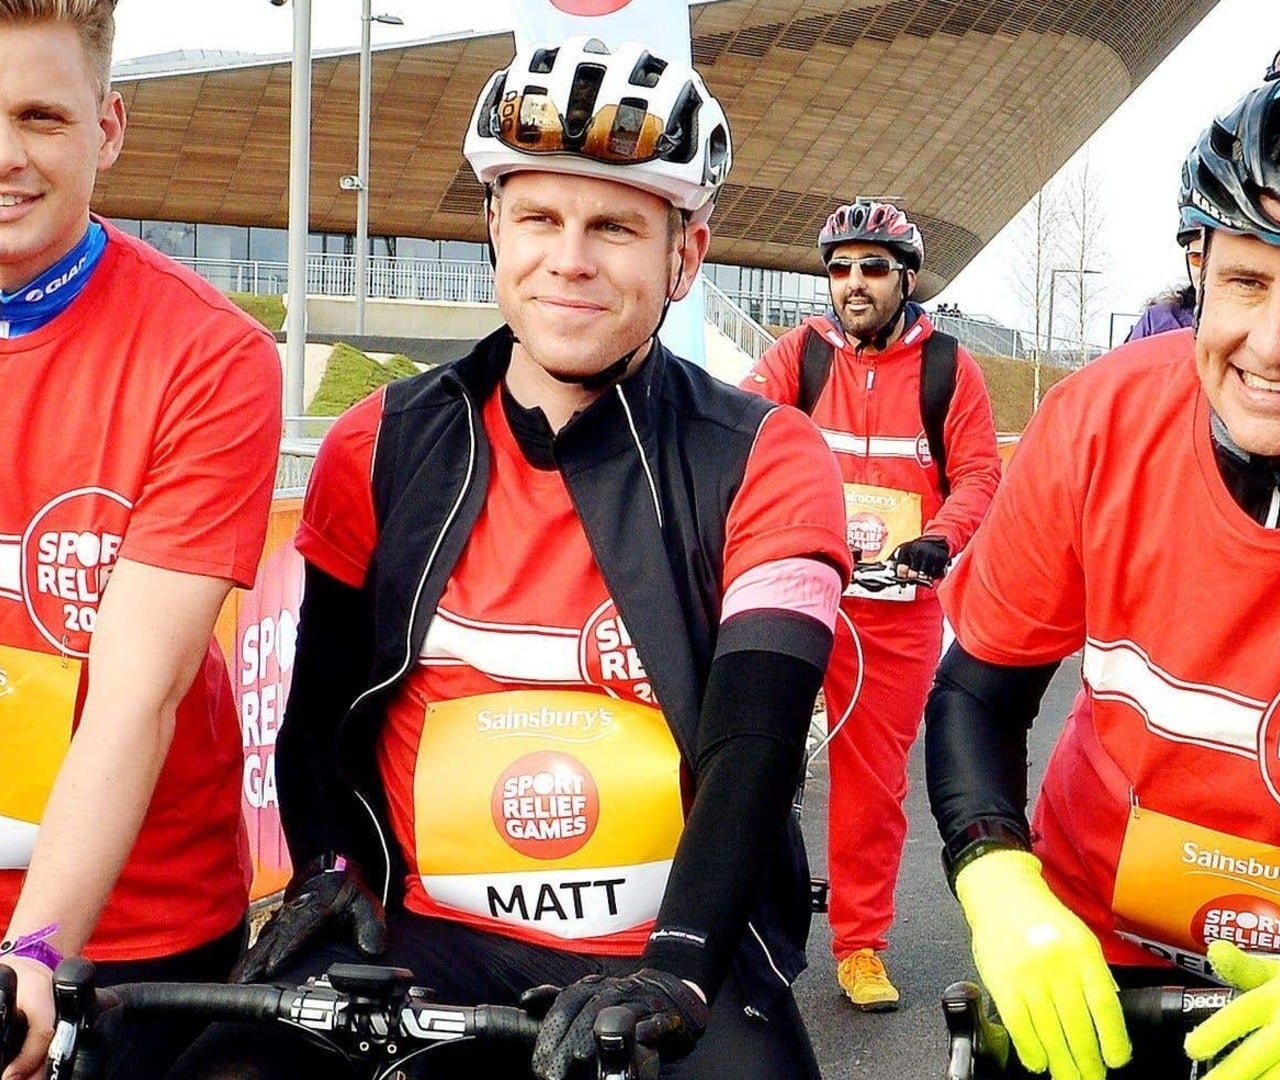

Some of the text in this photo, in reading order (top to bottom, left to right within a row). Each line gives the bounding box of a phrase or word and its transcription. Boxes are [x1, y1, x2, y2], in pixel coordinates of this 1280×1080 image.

[38, 531, 122, 568] SPOR
[63, 603, 96, 632] 20
[242, 608, 298, 687] SPO
[477, 707, 614, 731] Sainsbury's
[503, 770, 586, 798] SPORT
[503, 796, 586, 819] RELIEF
[505, 816, 587, 840] GAMES
[487, 878, 627, 921] MATT
